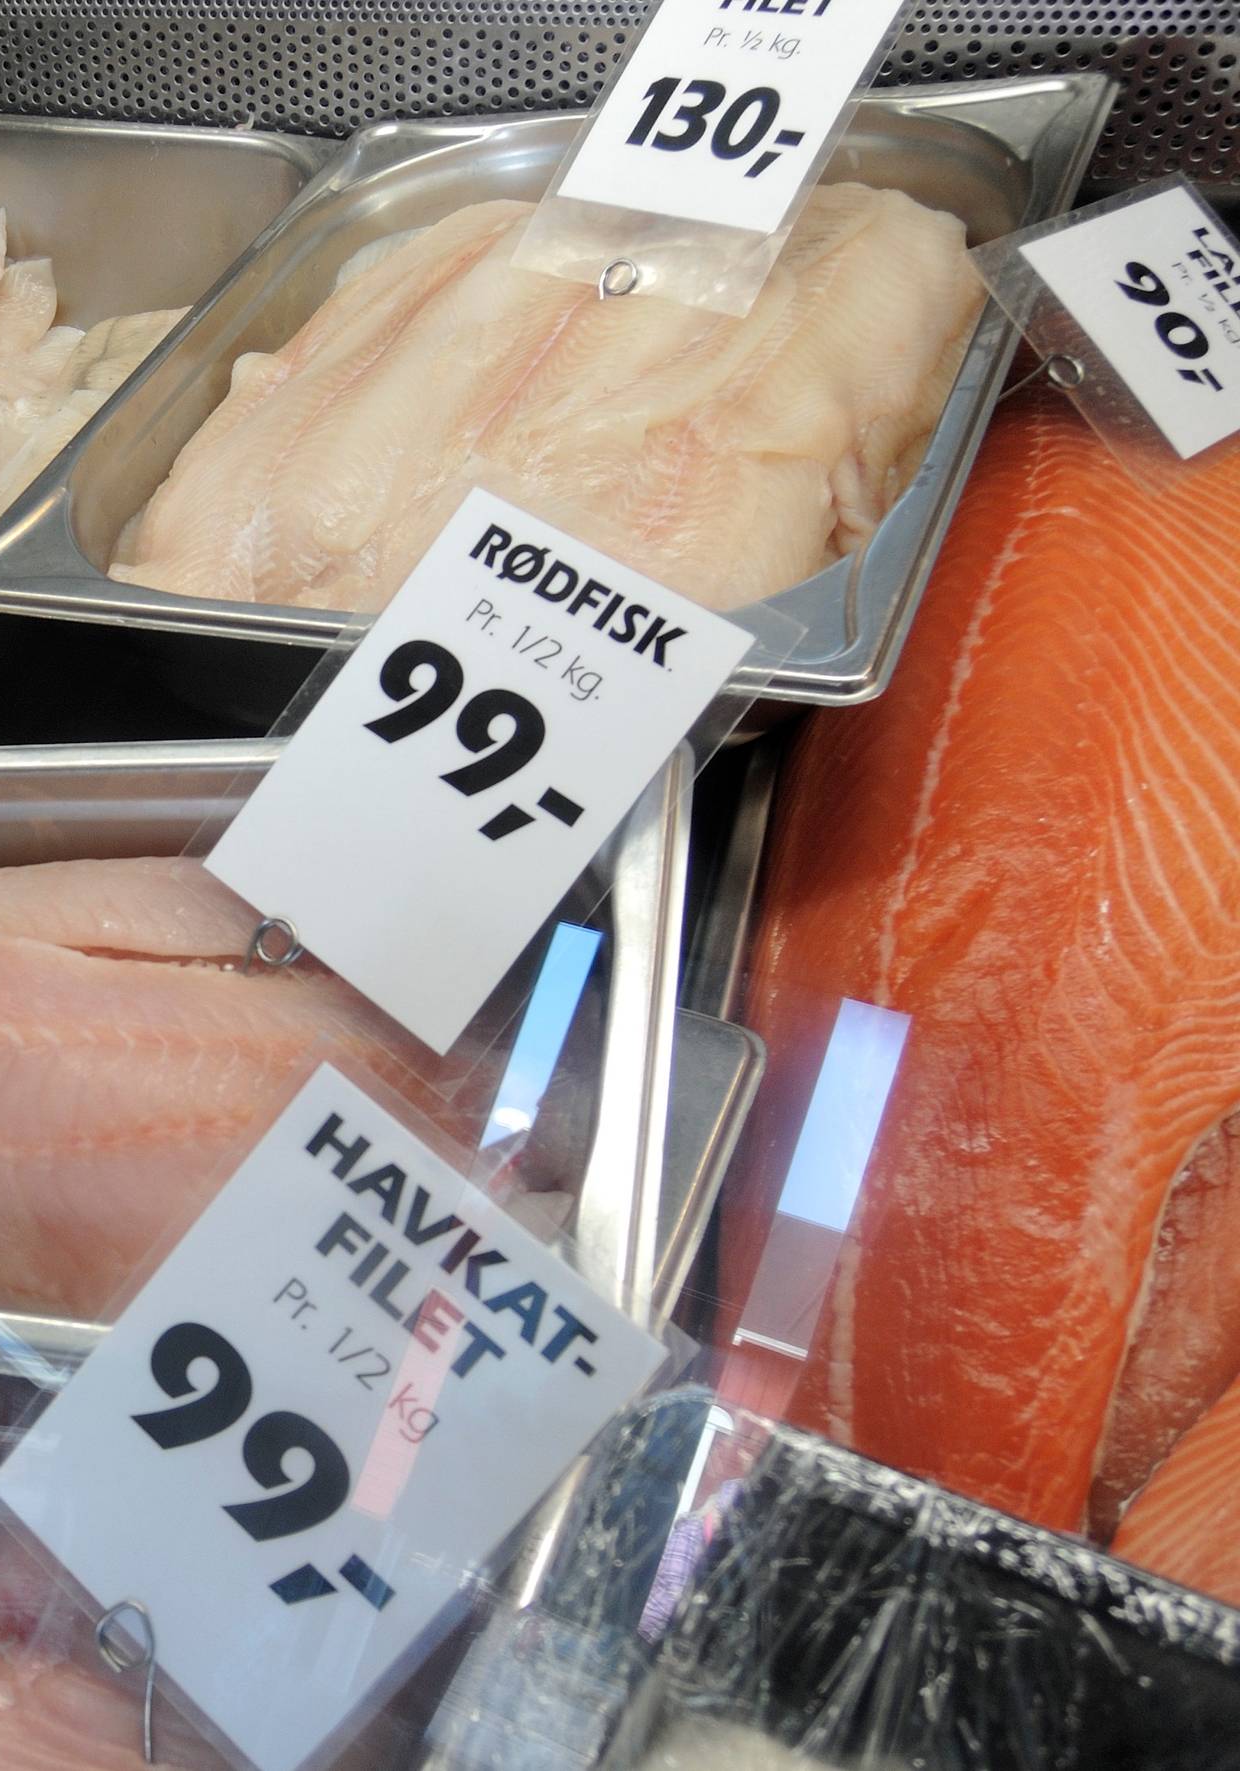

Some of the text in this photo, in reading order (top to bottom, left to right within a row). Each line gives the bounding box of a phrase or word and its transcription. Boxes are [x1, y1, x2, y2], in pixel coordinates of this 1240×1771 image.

[703, 26, 731, 48] Pr.
[768, 32, 802, 60] kg.
[625, 76, 806, 178] 130,-
[1113, 261, 1224, 392] 90,-
[466, 598, 604, 701] Pr. 1/2 kg.
[362, 639, 585, 842] 99,-
[305, 1112, 598, 1377] HAVKAT-
[315, 1211, 507, 1379] FILET
[273, 1277, 439, 1444] Pr. 1/2 kg
[129, 1321, 396, 1612] 99,-
